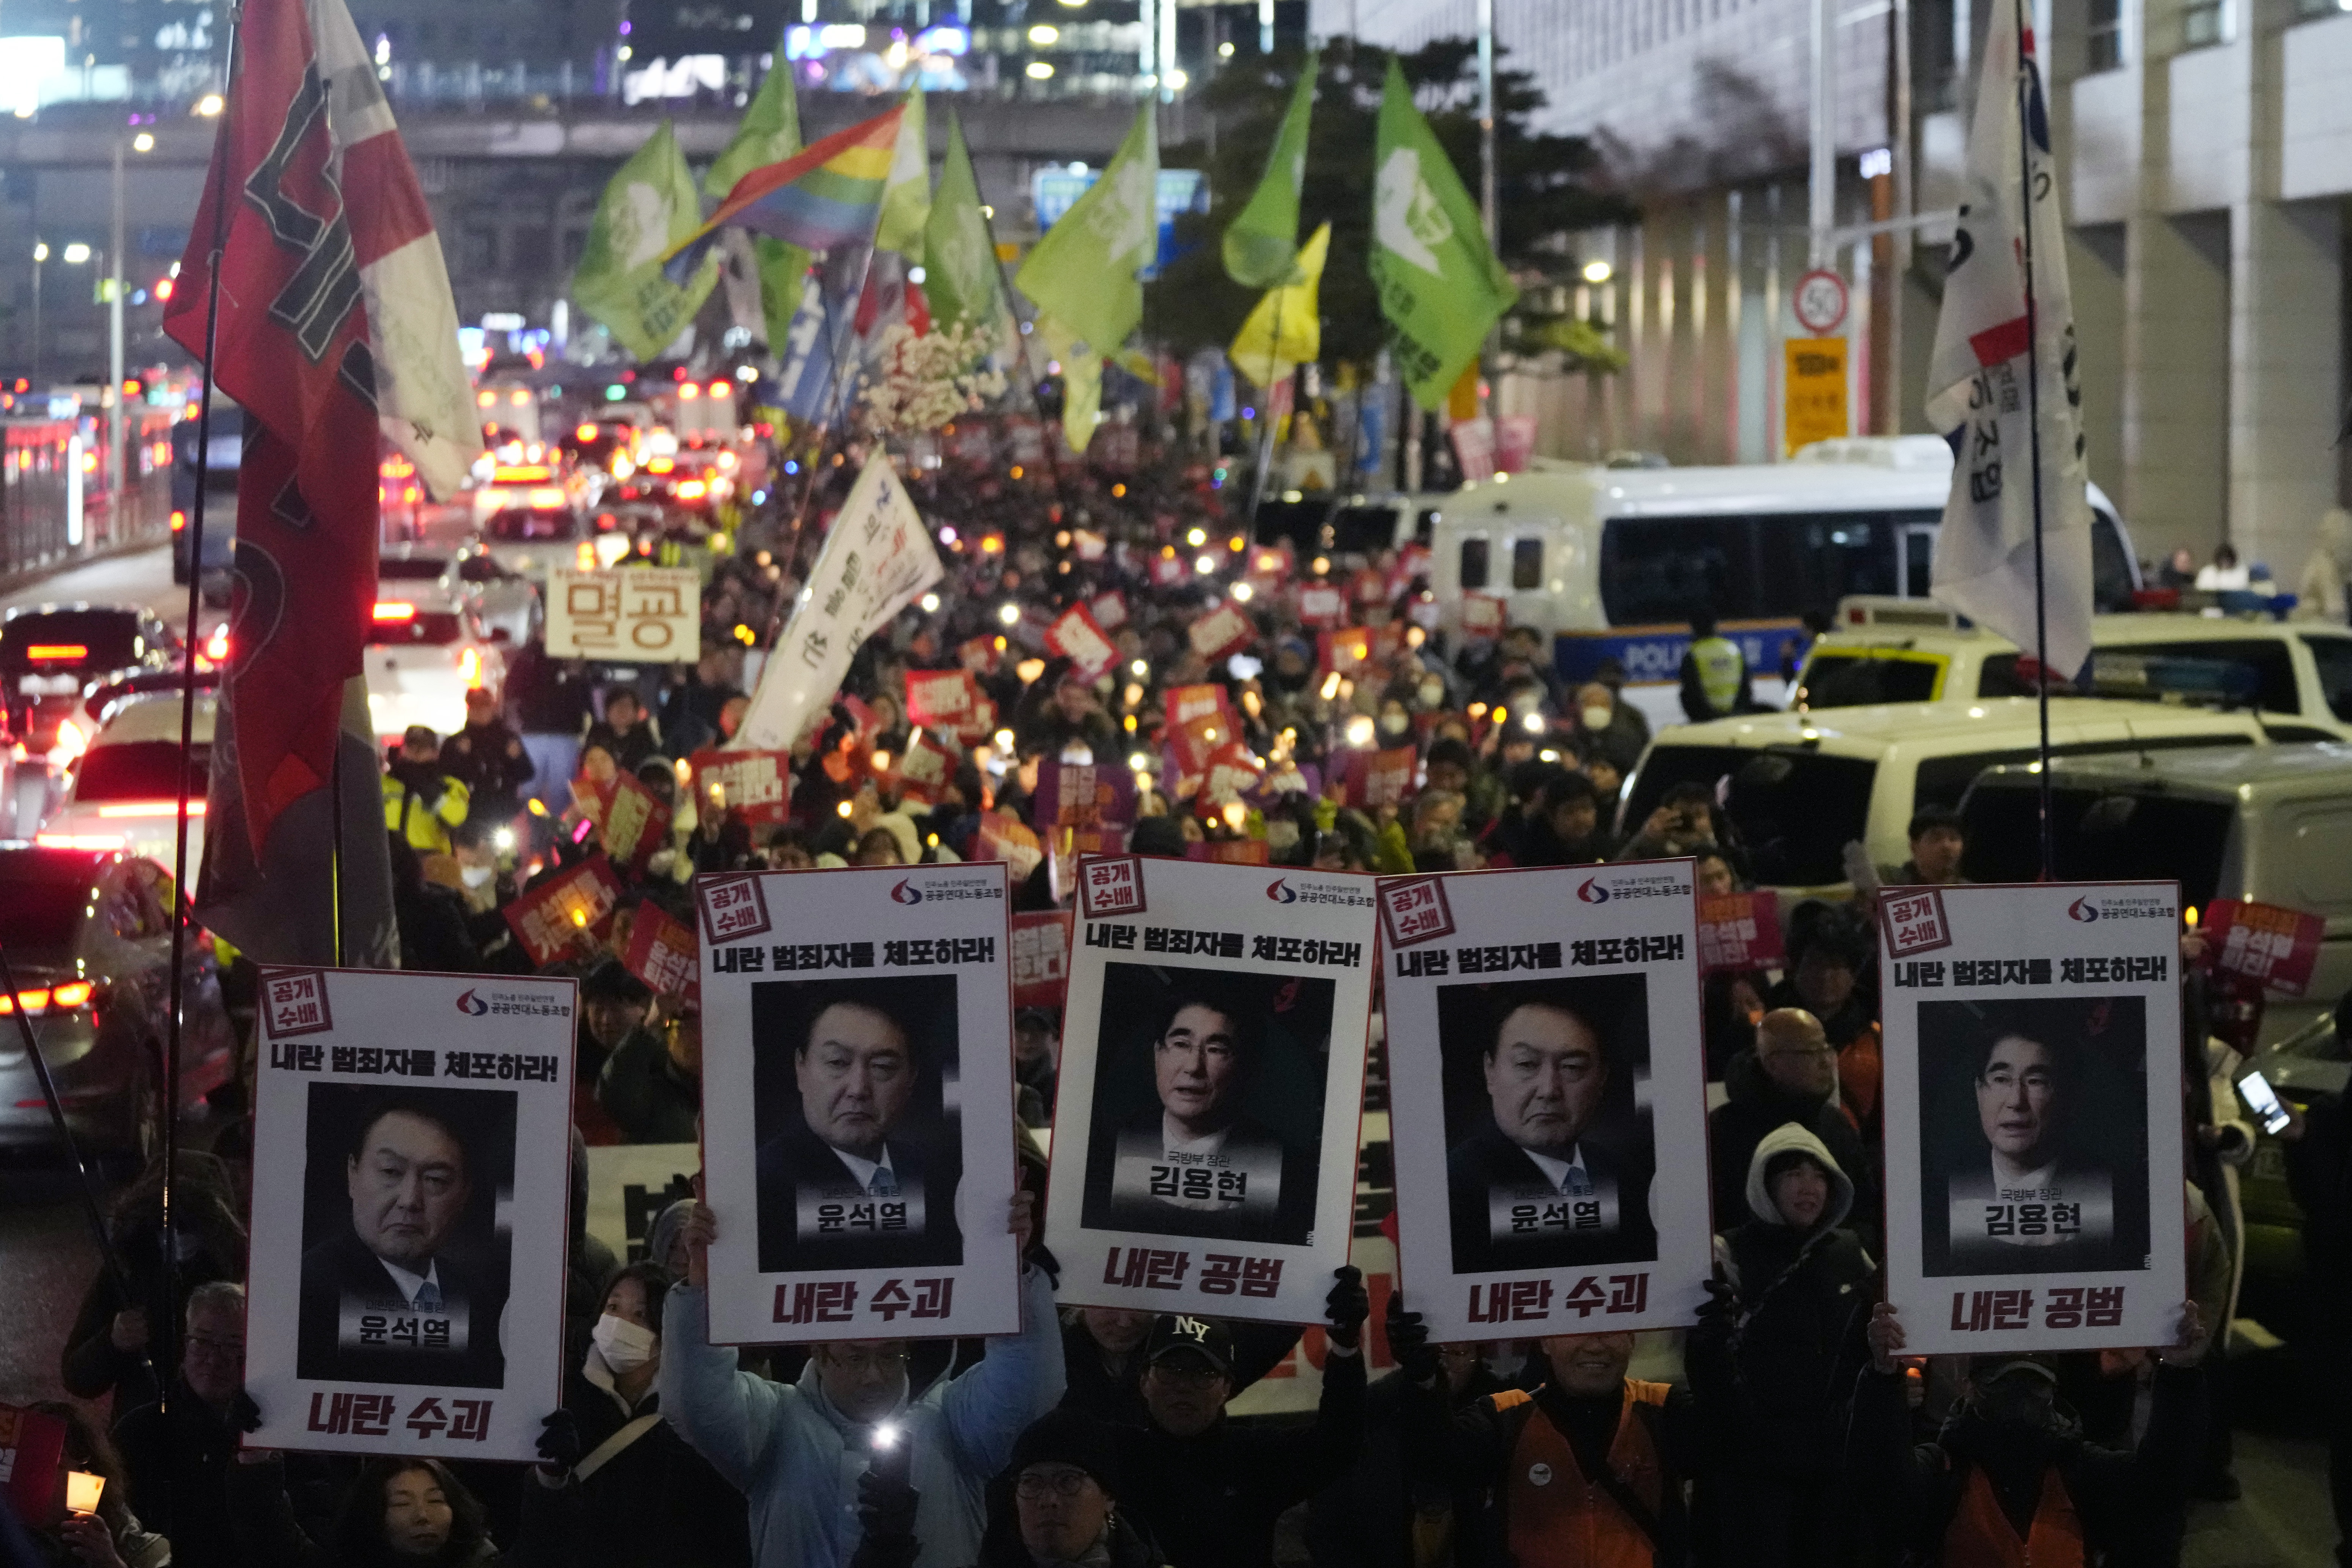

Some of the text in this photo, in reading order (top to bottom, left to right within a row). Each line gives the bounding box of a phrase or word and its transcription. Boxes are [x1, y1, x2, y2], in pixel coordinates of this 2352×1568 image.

[1091, 863, 1130, 885] 공개
[710, 882, 752, 909] 공개
[925, 888, 1003, 902] 공공연대노동조합
[1094, 886, 1133, 908] 수배
[1299, 892, 1374, 907] 공공연대노동조합
[1392, 885, 1433, 913] 공개
[1612, 884, 1691, 899] 공공연대노동조합
[716, 907, 757, 932] 수배
[1400, 909, 1440, 935] 수배
[1893, 896, 1932, 923] 공개
[2101, 907, 2176, 919] 공공연대노동조합
[1086, 923, 1361, 967] 내란 범죄자를 체포하라!
[1899, 920, 1938, 946] 수배
[713, 937, 995, 973] 내란 범죄자를 체포하라!
[1396, 934, 1683, 977] 내란 범죄자를 체포하라!
[1895, 956, 2166, 987] 내란 범죄자를 체포하라!
[272, 973, 314, 1003] 공개
[277, 1003, 320, 1027] 수배
[491, 1002, 570, 1017] 공공연대노동조합
[271, 1044, 558, 1082] 내란 범죄자를 체포하라!
[1168, 1151, 1231, 1168] 국방부 장관
[1150, 1165, 1247, 1202] 김용현
[2001, 1188, 2062, 1201] 국방부 장관
[818, 1202, 907, 1233] 윤석열
[1512, 1200, 1601, 1233] 윤석열
[1986, 1203, 2081, 1236] 김용현
[1103, 1247, 1284, 1298] 내란 공범
[772, 1278, 955, 1324] 내란 수괴
[1468, 1273, 1649, 1324] 내란 수괴
[1951, 1286, 2125, 1331] 내란 공범
[360, 1315, 450, 1348] 윤석열
[1172, 1315, 1211, 1343] NY
[307, 1392, 493, 1442] 내란 수괴
